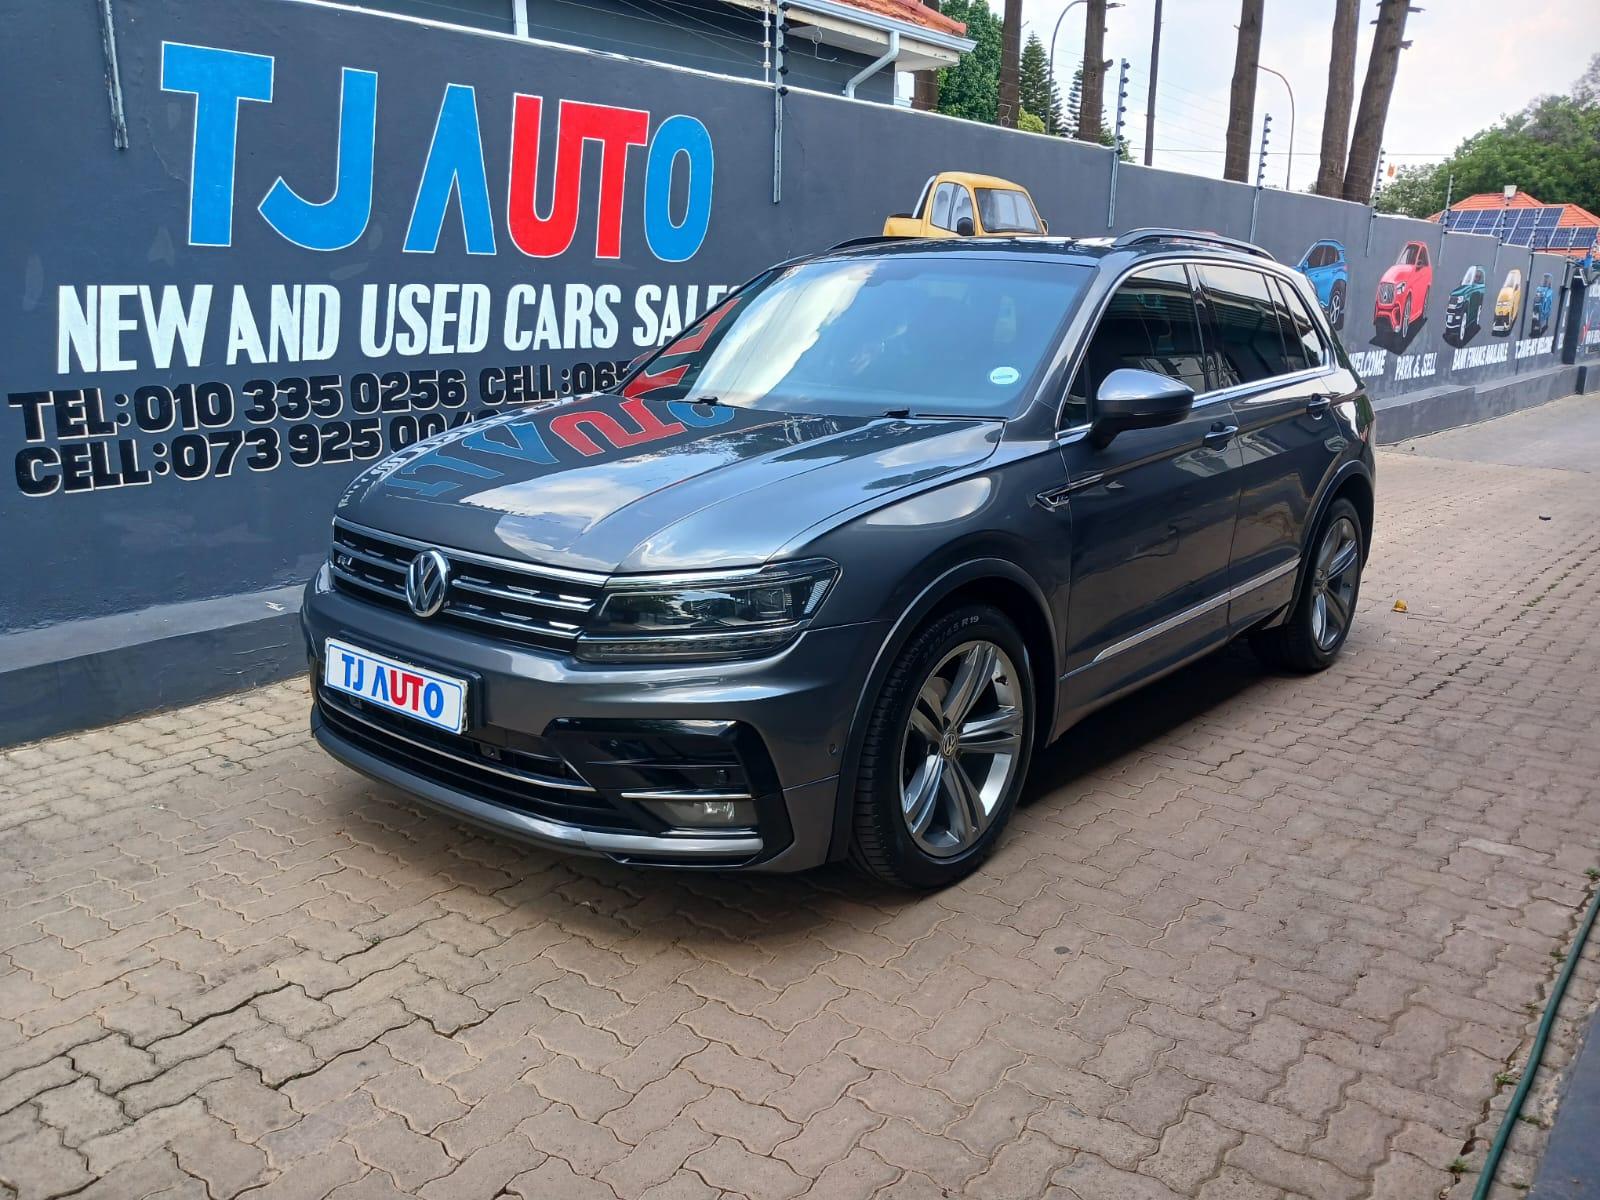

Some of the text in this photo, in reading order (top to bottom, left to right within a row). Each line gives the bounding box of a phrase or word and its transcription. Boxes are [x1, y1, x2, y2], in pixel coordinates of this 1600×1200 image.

[160, 40, 714, 262] TJ AUTO
[57, 283, 740, 374] NEW AND USED CARS SAL
[1394, 352, 1437, 381] PARK & SELL
[243, 375, 345, 424] 335
[350, 370, 467, 415] 0256
[287, 417, 383, 468] 925
[341, 653, 444, 719] TJ AUTO
